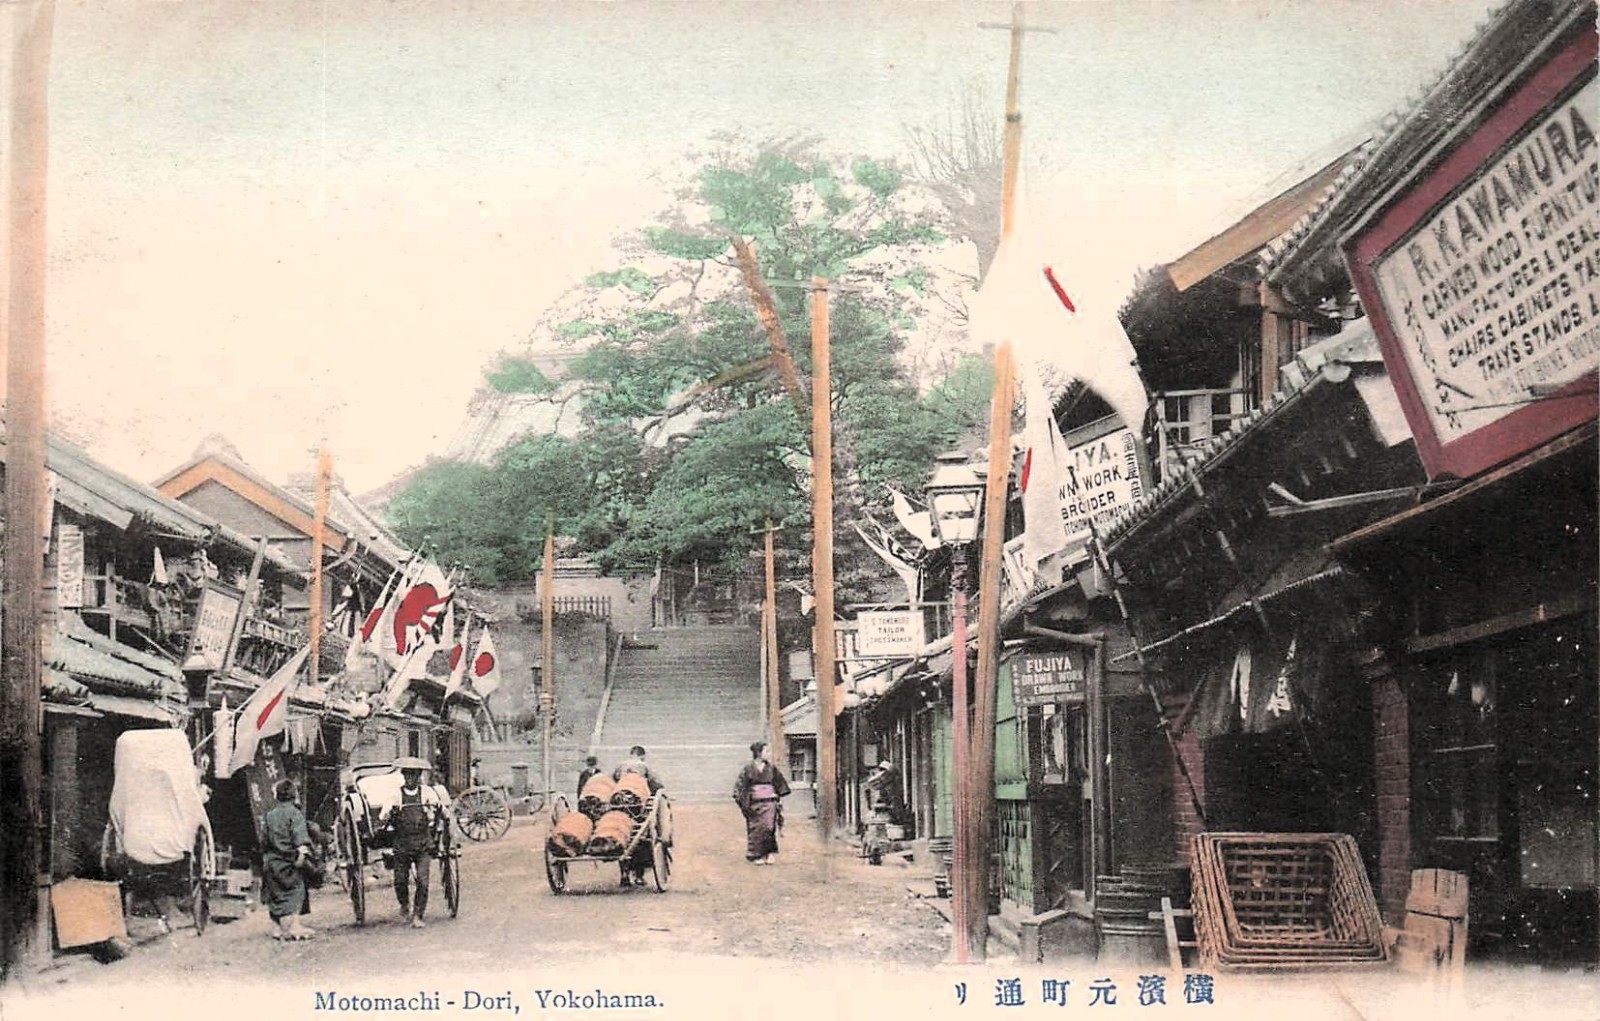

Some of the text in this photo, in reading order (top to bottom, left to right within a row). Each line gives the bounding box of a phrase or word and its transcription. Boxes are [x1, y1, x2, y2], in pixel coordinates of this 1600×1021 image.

[1432, 107, 1597, 266] KAWAMURA
[1422, 263, 1477, 319] CARVED
[1478, 231, 1521, 278] WOOD
[1441, 256, 1543, 340] MANUFACTURER
[1556, 217, 1599, 262] DEAL
[1478, 340, 1521, 381] TRAYS
[1083, 465, 1122, 491] WORK
[1061, 491, 1116, 520] BROIDER
[1026, 656, 1072, 673] FUJIYA
[1057, 670, 1084, 682] WORK
